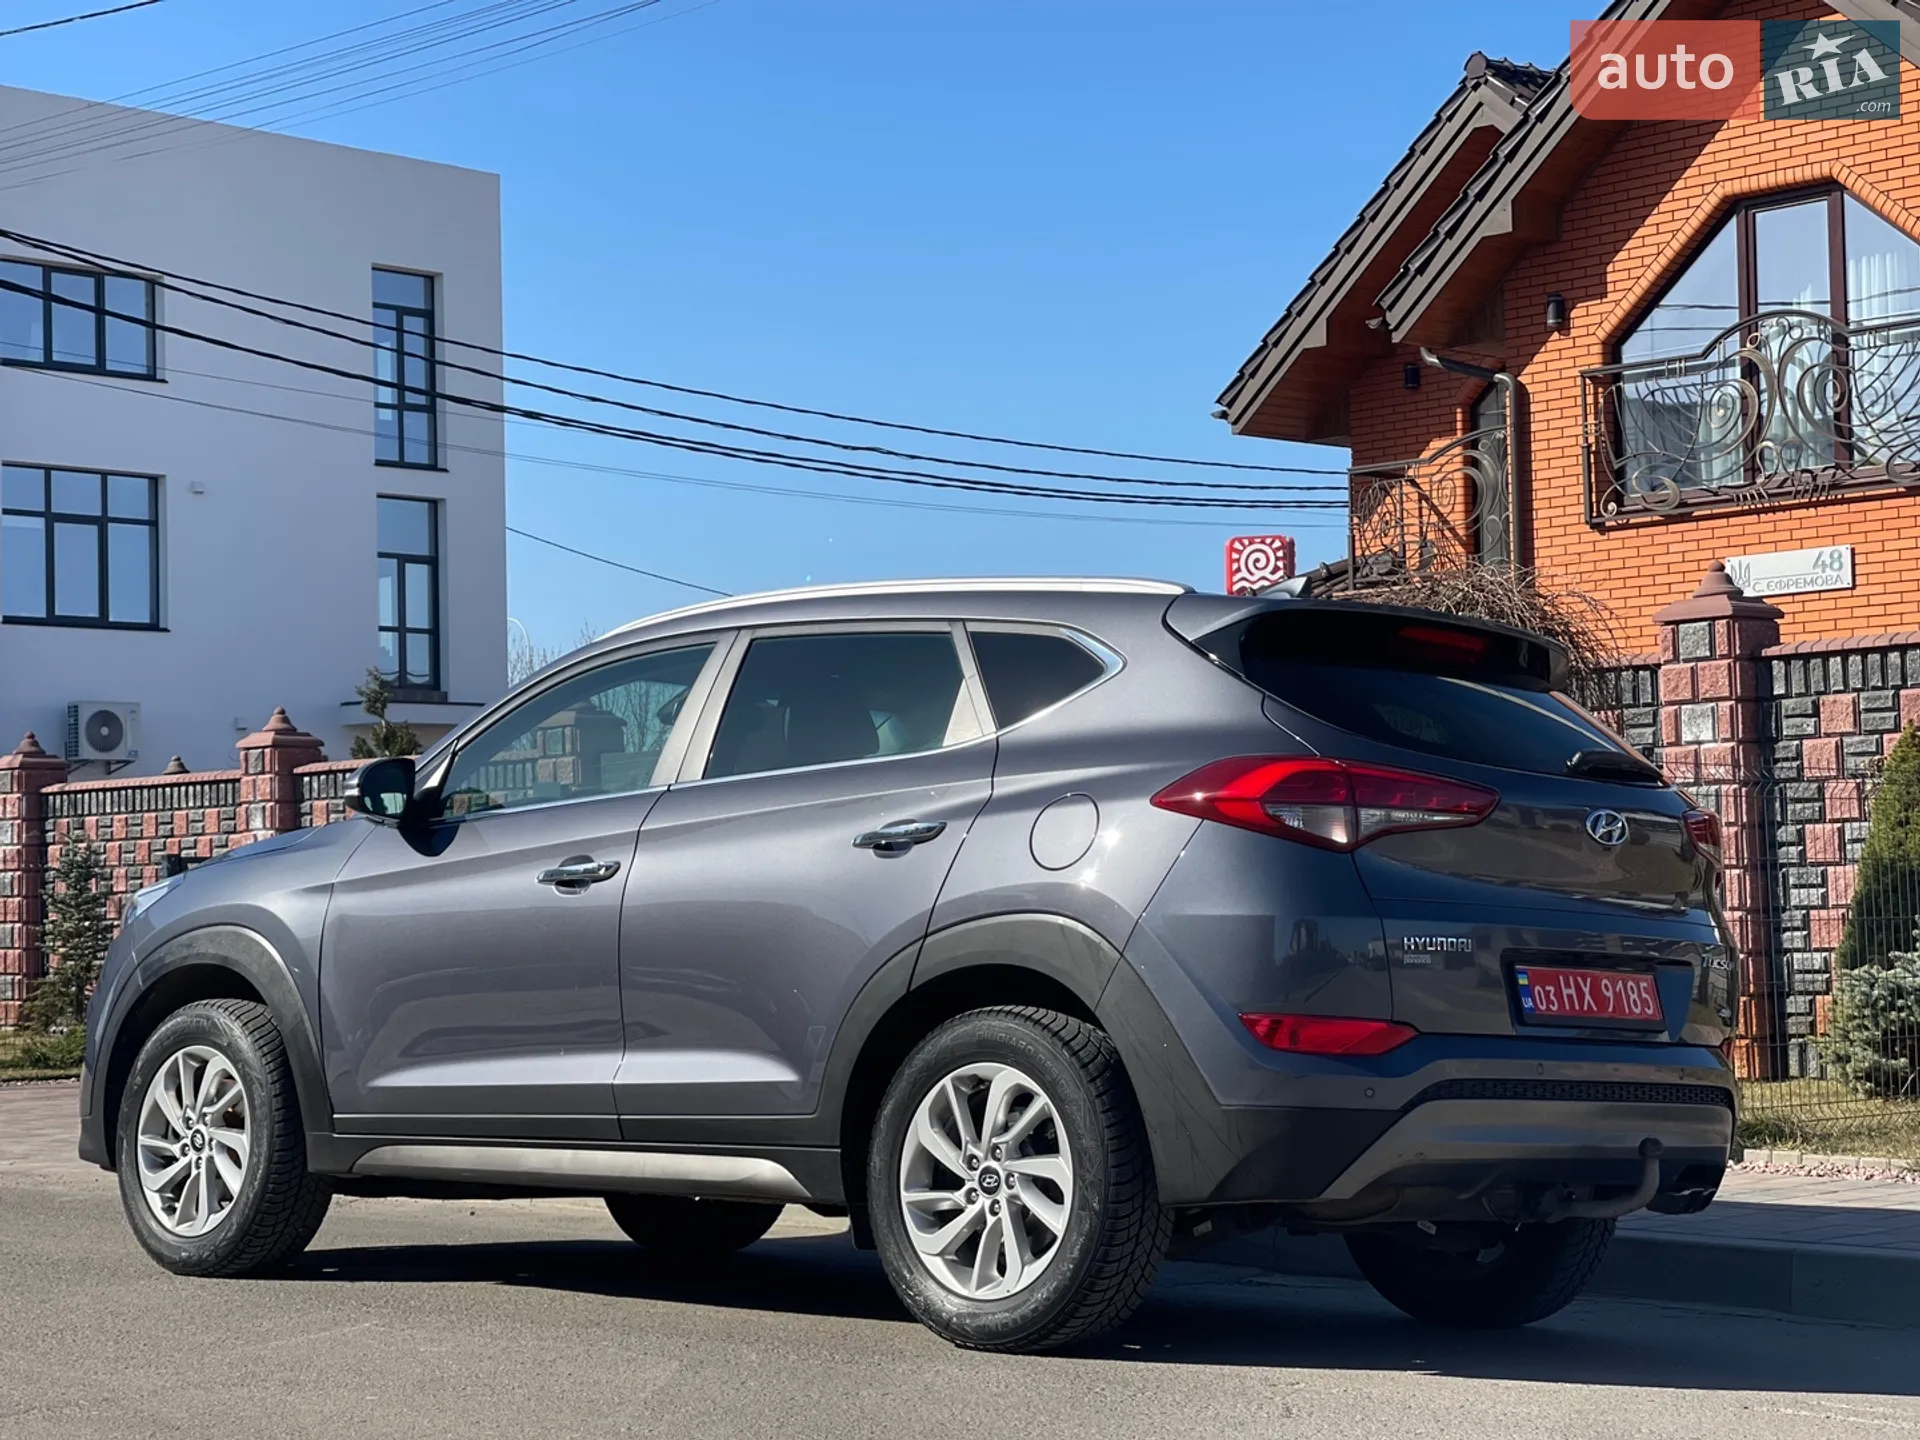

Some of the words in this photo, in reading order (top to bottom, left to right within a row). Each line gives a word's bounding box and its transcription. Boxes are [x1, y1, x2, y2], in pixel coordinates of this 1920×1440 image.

[1812, 549, 1843, 573] 48
[1766, 574, 1844, 592] ЄФРЕМОВА
[1403, 937, 1472, 952] HYUNDAI
[1522, 997, 1535, 1009] UA
[1534, 985, 1559, 1011] 03
[1559, 975, 1597, 1012] HX
[1601, 978, 1654, 1015] 9185
